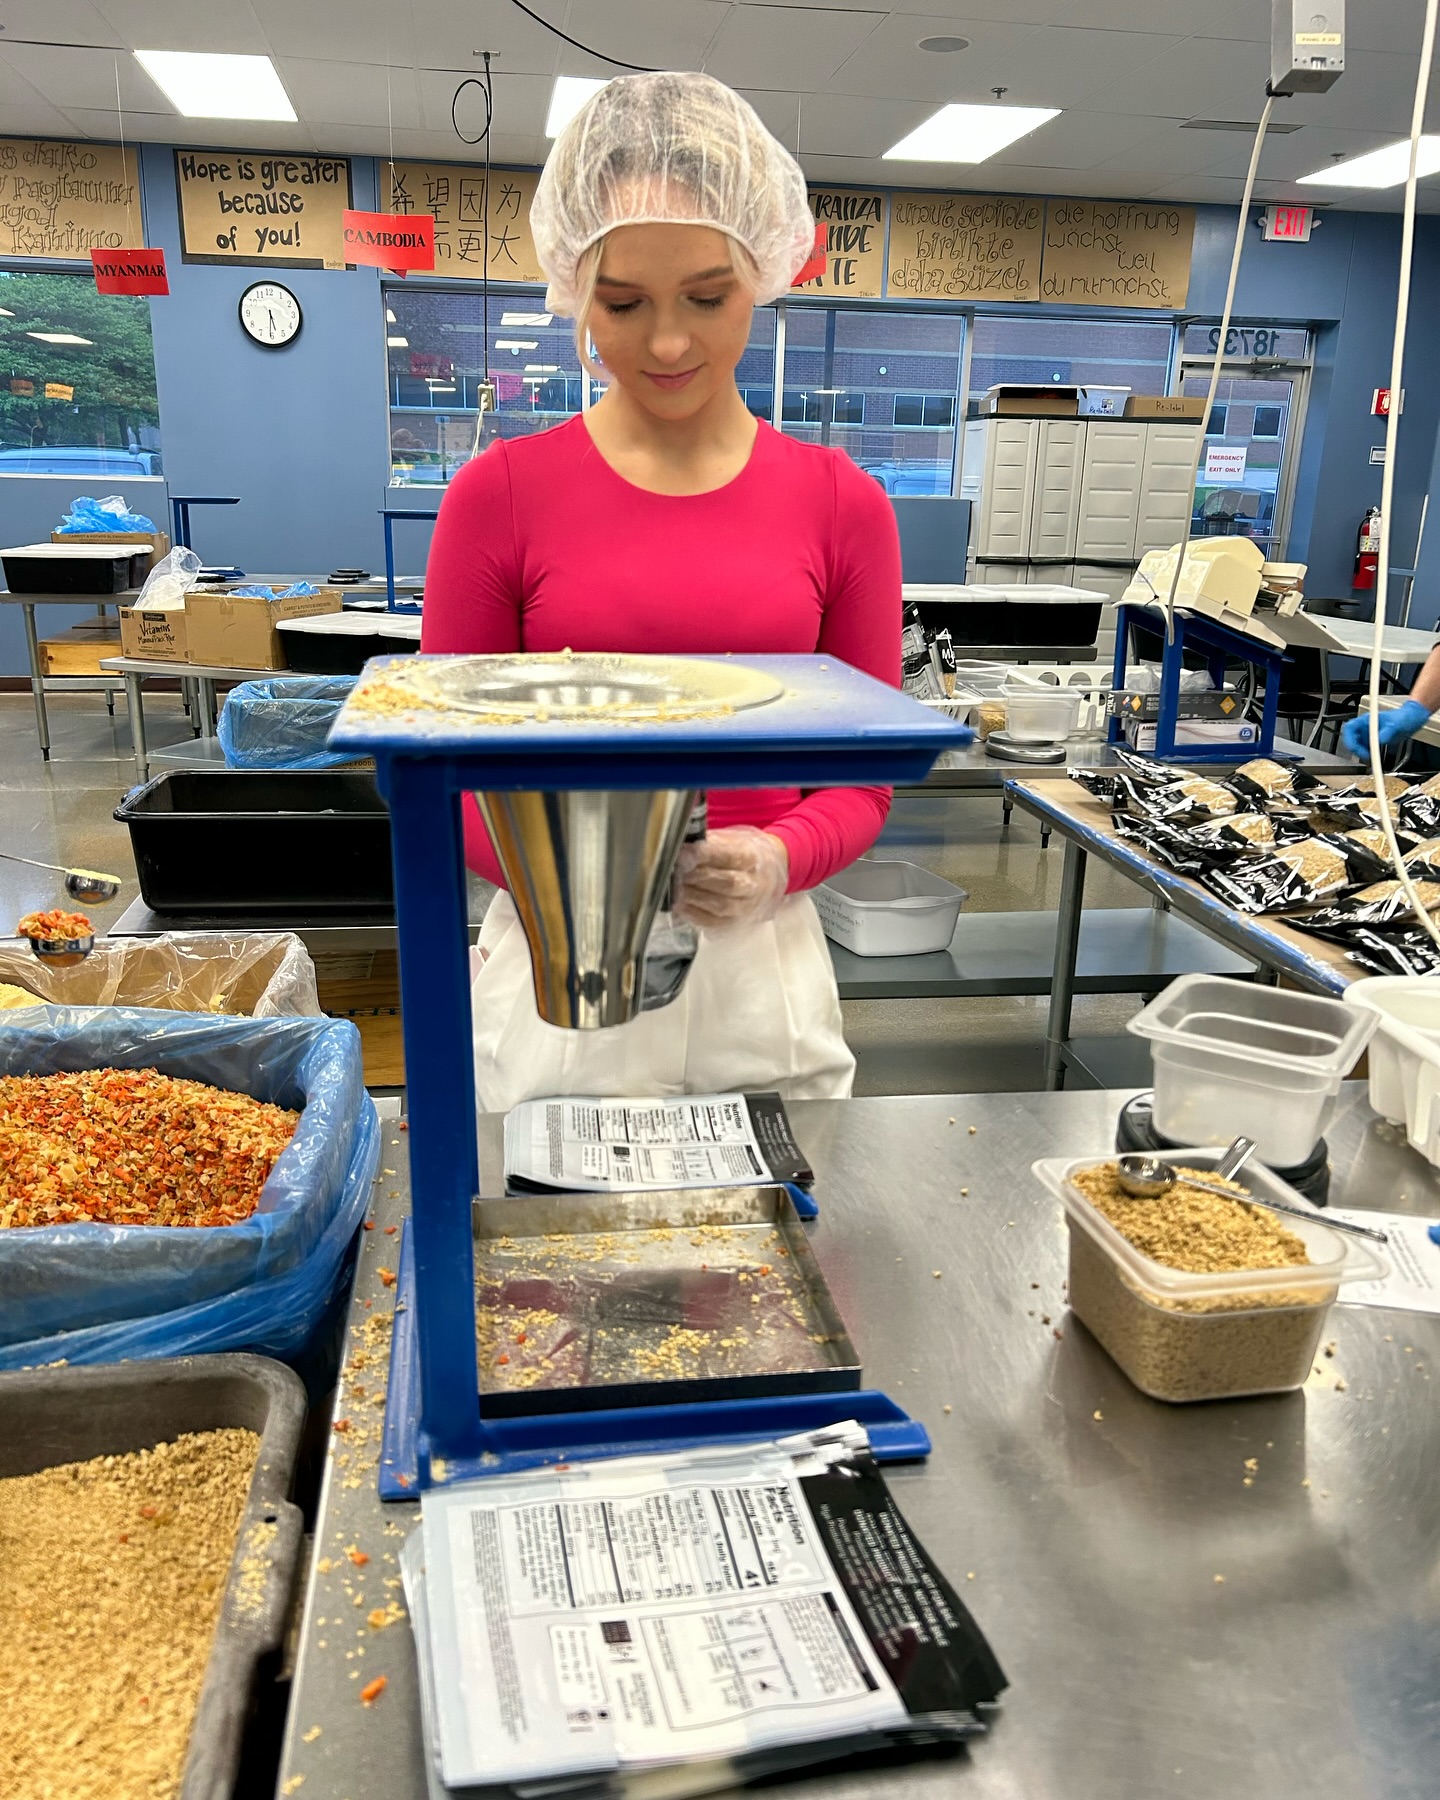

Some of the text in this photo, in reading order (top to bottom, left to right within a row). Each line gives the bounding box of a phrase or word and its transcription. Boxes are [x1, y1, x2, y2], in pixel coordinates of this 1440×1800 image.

[180, 155, 346, 191] Hope is greater
[218, 190, 304, 215] because
[1054, 202, 1084, 225] die
[1274, 207, 1308, 237] EXIT
[216, 221, 301, 253] of you!
[343, 228, 426, 248] CAMBODIA
[826, 224, 875, 253] NDE
[96, 264, 166, 278] MYANMAR
[256, 290, 264, 298] 11
[265, 288, 273, 296] 12
[287, 300, 292, 308] 2
[291, 311, 296, 319] 3
[776, 1485, 805, 1544] Nutrition
